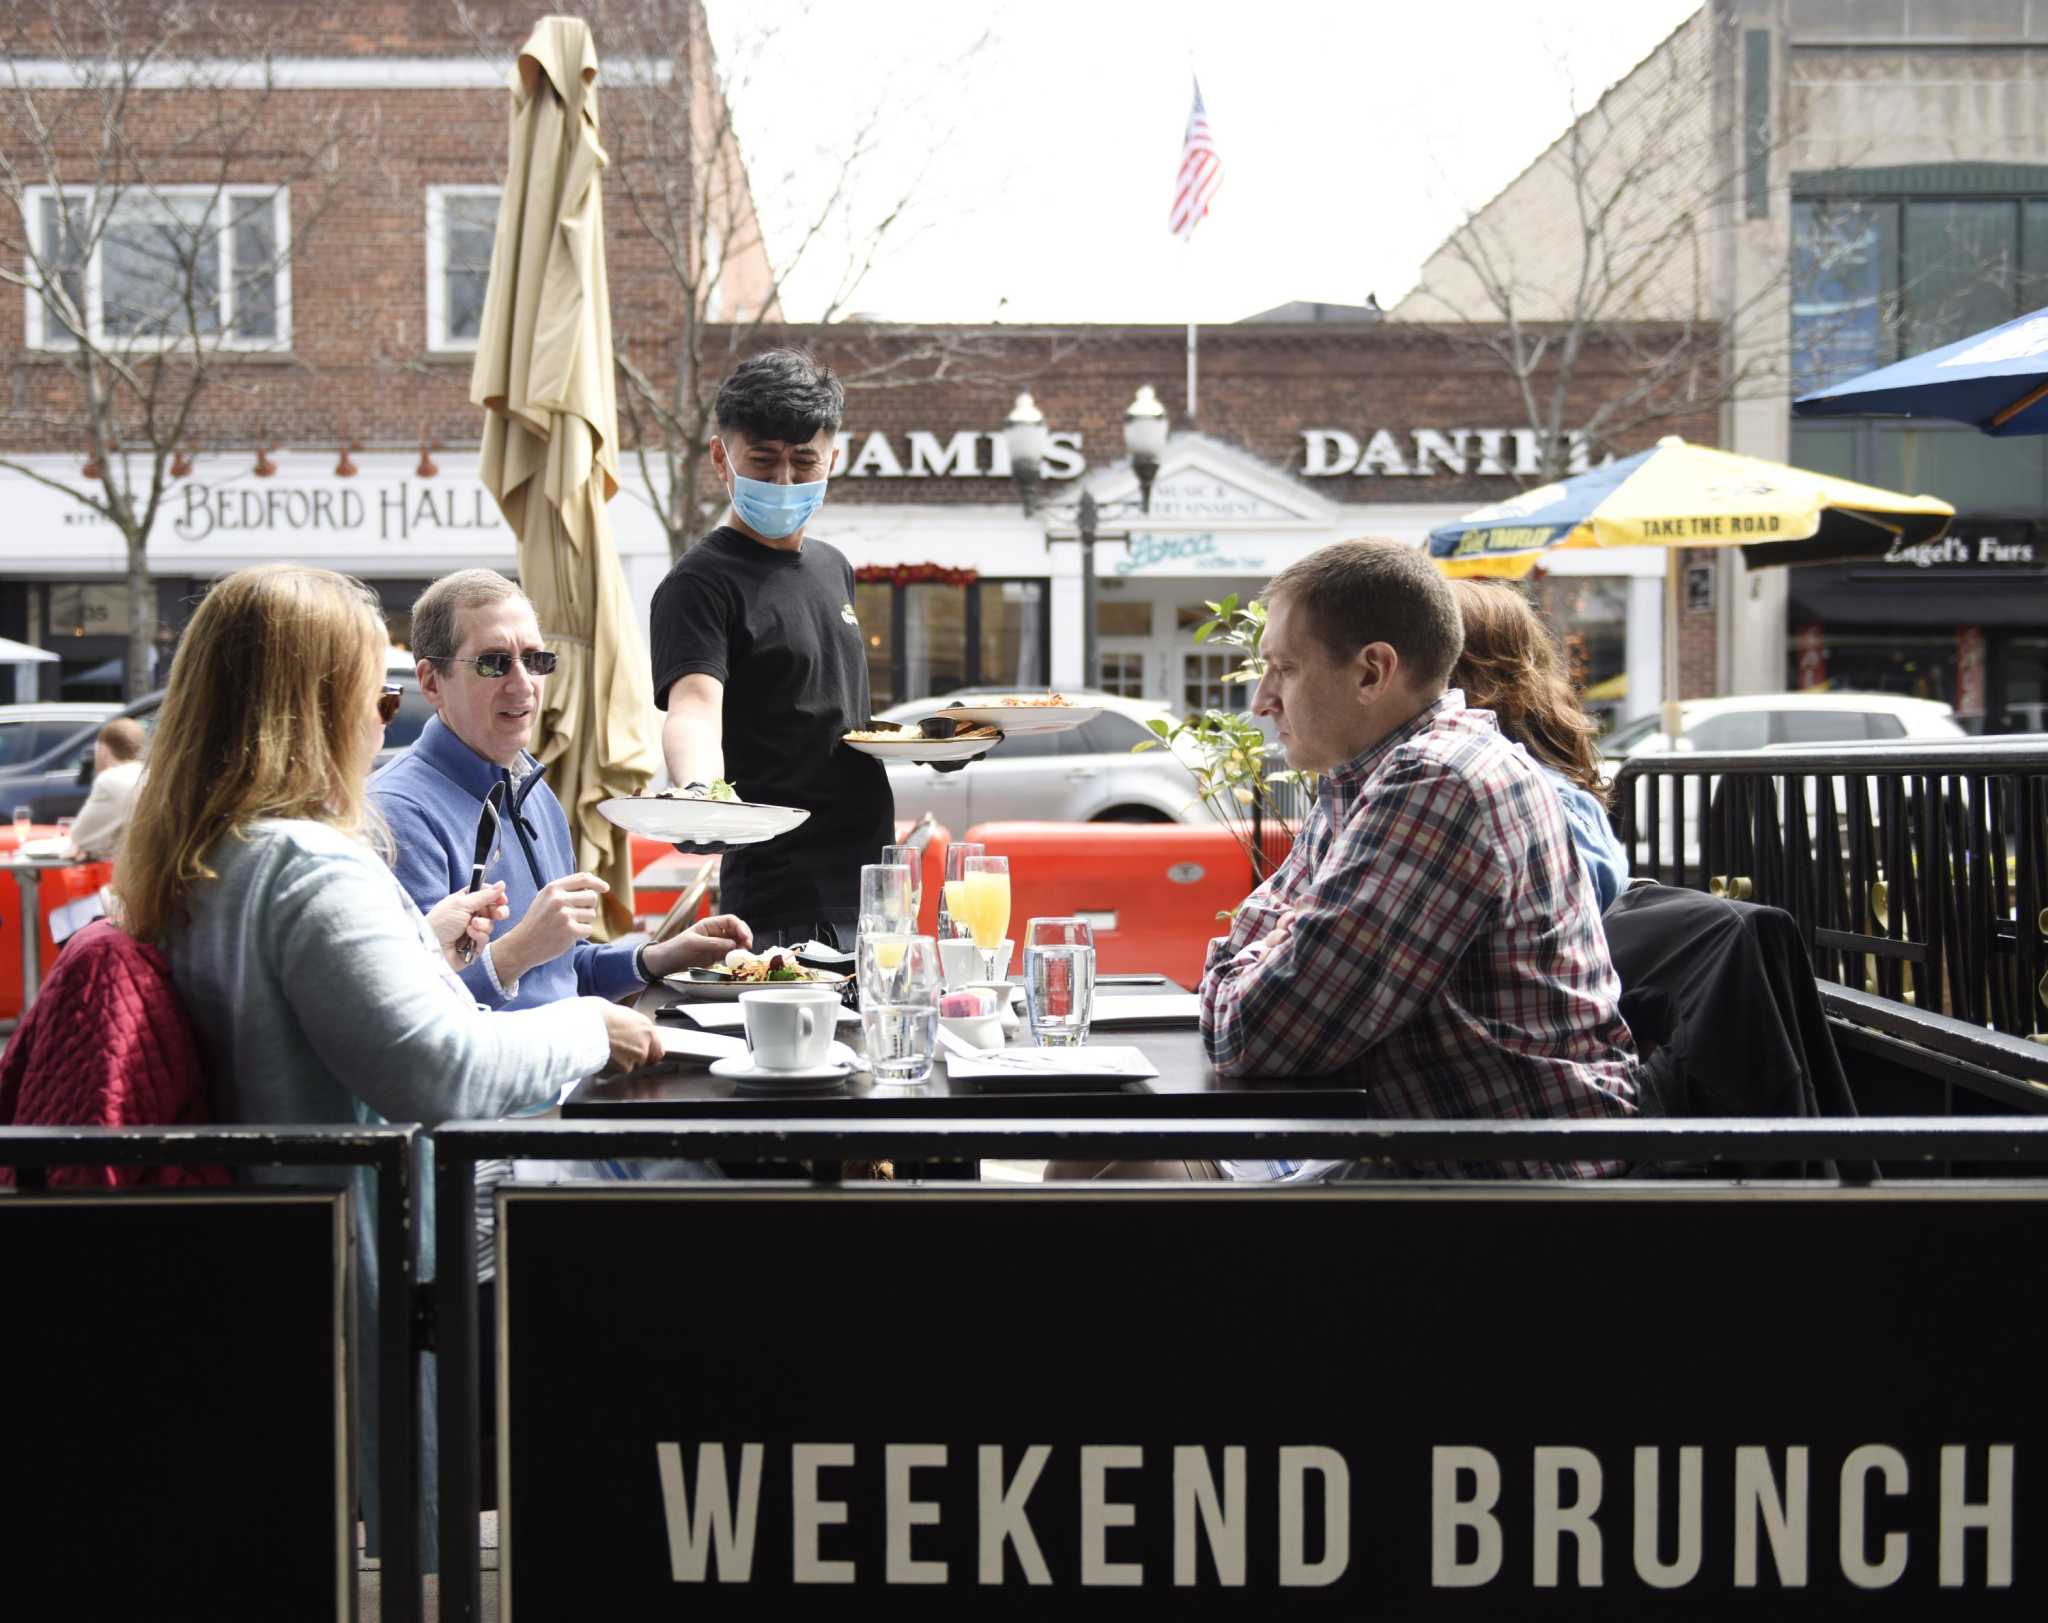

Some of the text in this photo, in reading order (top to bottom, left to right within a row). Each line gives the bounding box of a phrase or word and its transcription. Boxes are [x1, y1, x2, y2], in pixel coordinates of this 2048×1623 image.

[174, 482, 500, 541] BEDFORD HALL
[1642, 515, 1780, 537] TAKE THE ROAD
[1977, 536, 2033, 562] Furs
[657, 1442, 2014, 1588] WEEKEND BRUNCH
